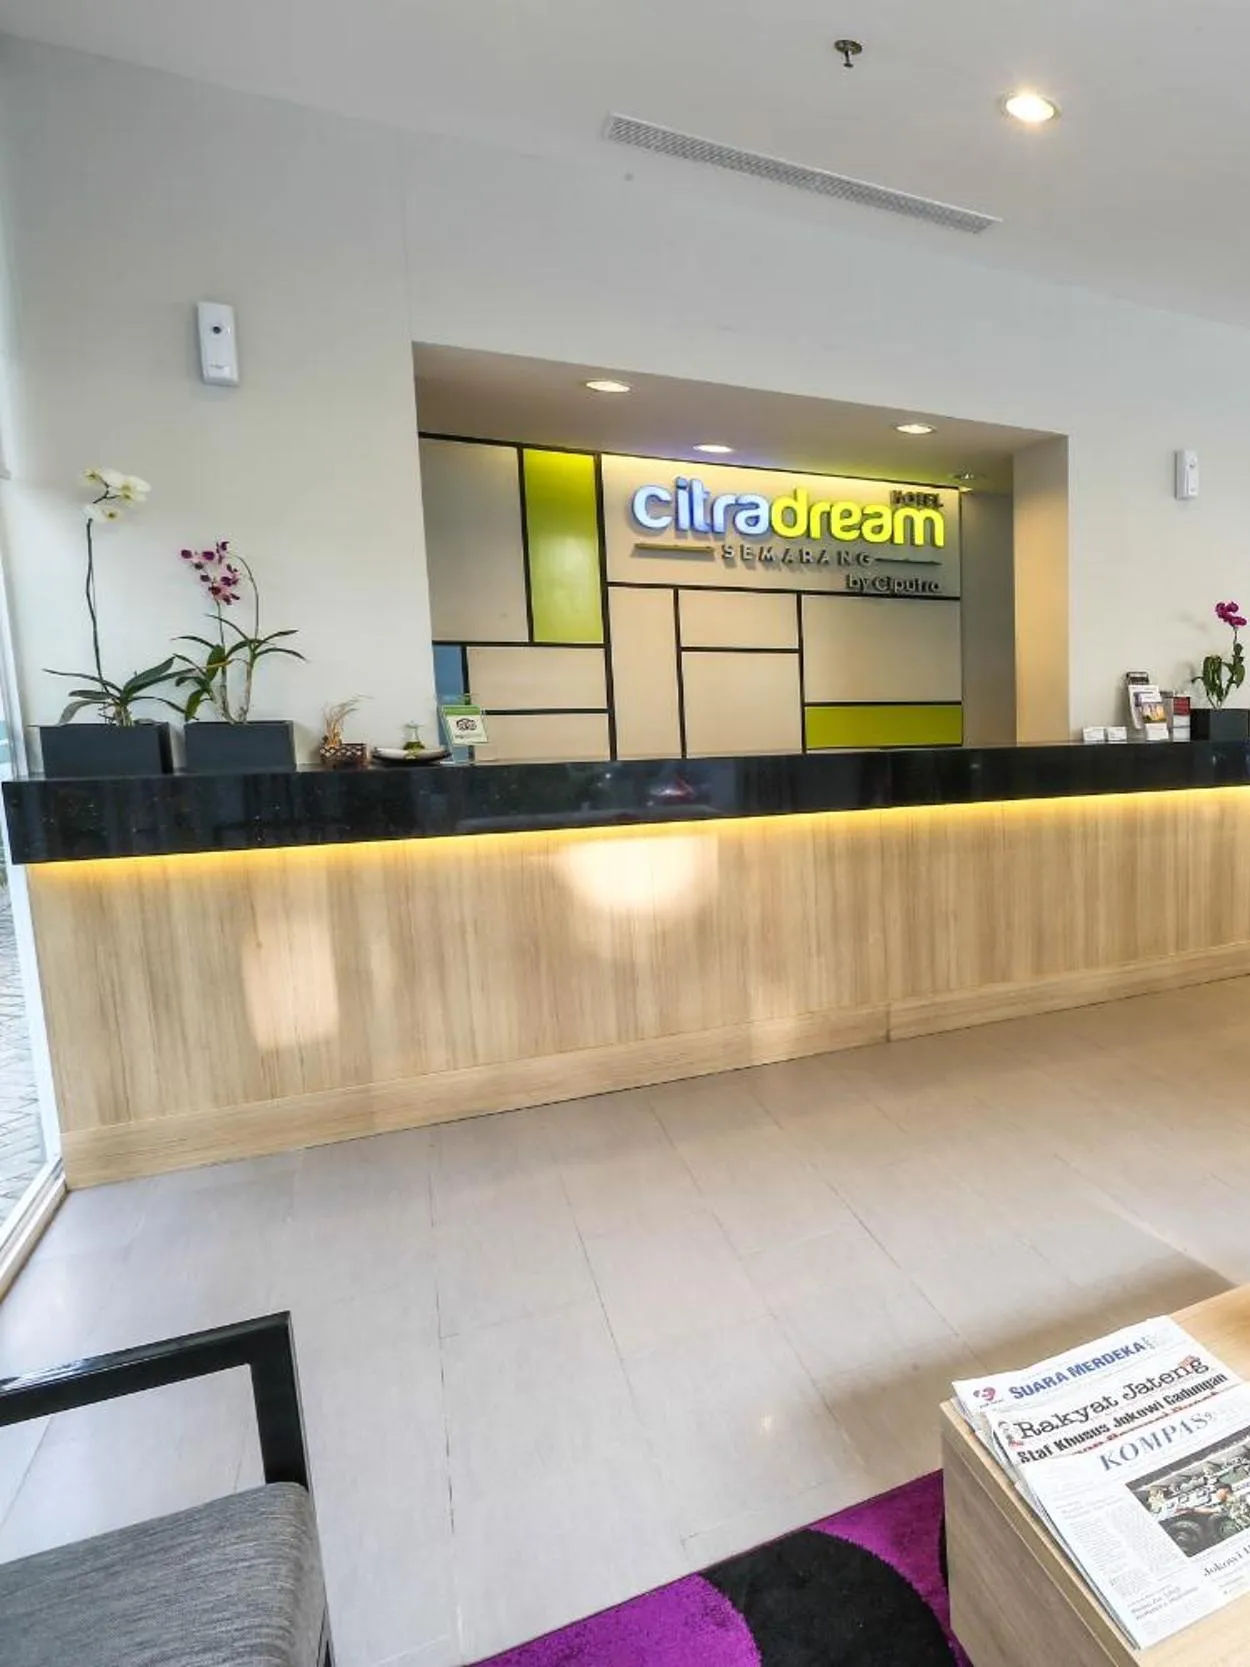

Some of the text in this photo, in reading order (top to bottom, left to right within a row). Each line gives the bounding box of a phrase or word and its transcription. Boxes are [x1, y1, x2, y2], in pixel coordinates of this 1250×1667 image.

[632, 476, 945, 547] citradream
[722, 543, 874, 567] SEMARANG
[846, 574, 942, 594] by Ciputra
[1008, 1370, 1068, 1400] SUARA
[1066, 1340, 1146, 1378] MERDEKA
[1013, 1357, 1210, 1440] Rakyat Jateng
[1017, 1373, 1228, 1464] Staf Khusus Jokowi Gadungan
[1099, 1412, 1207, 1472] KOMPAS
[1202, 1552, 1243, 1577] Jokowi
